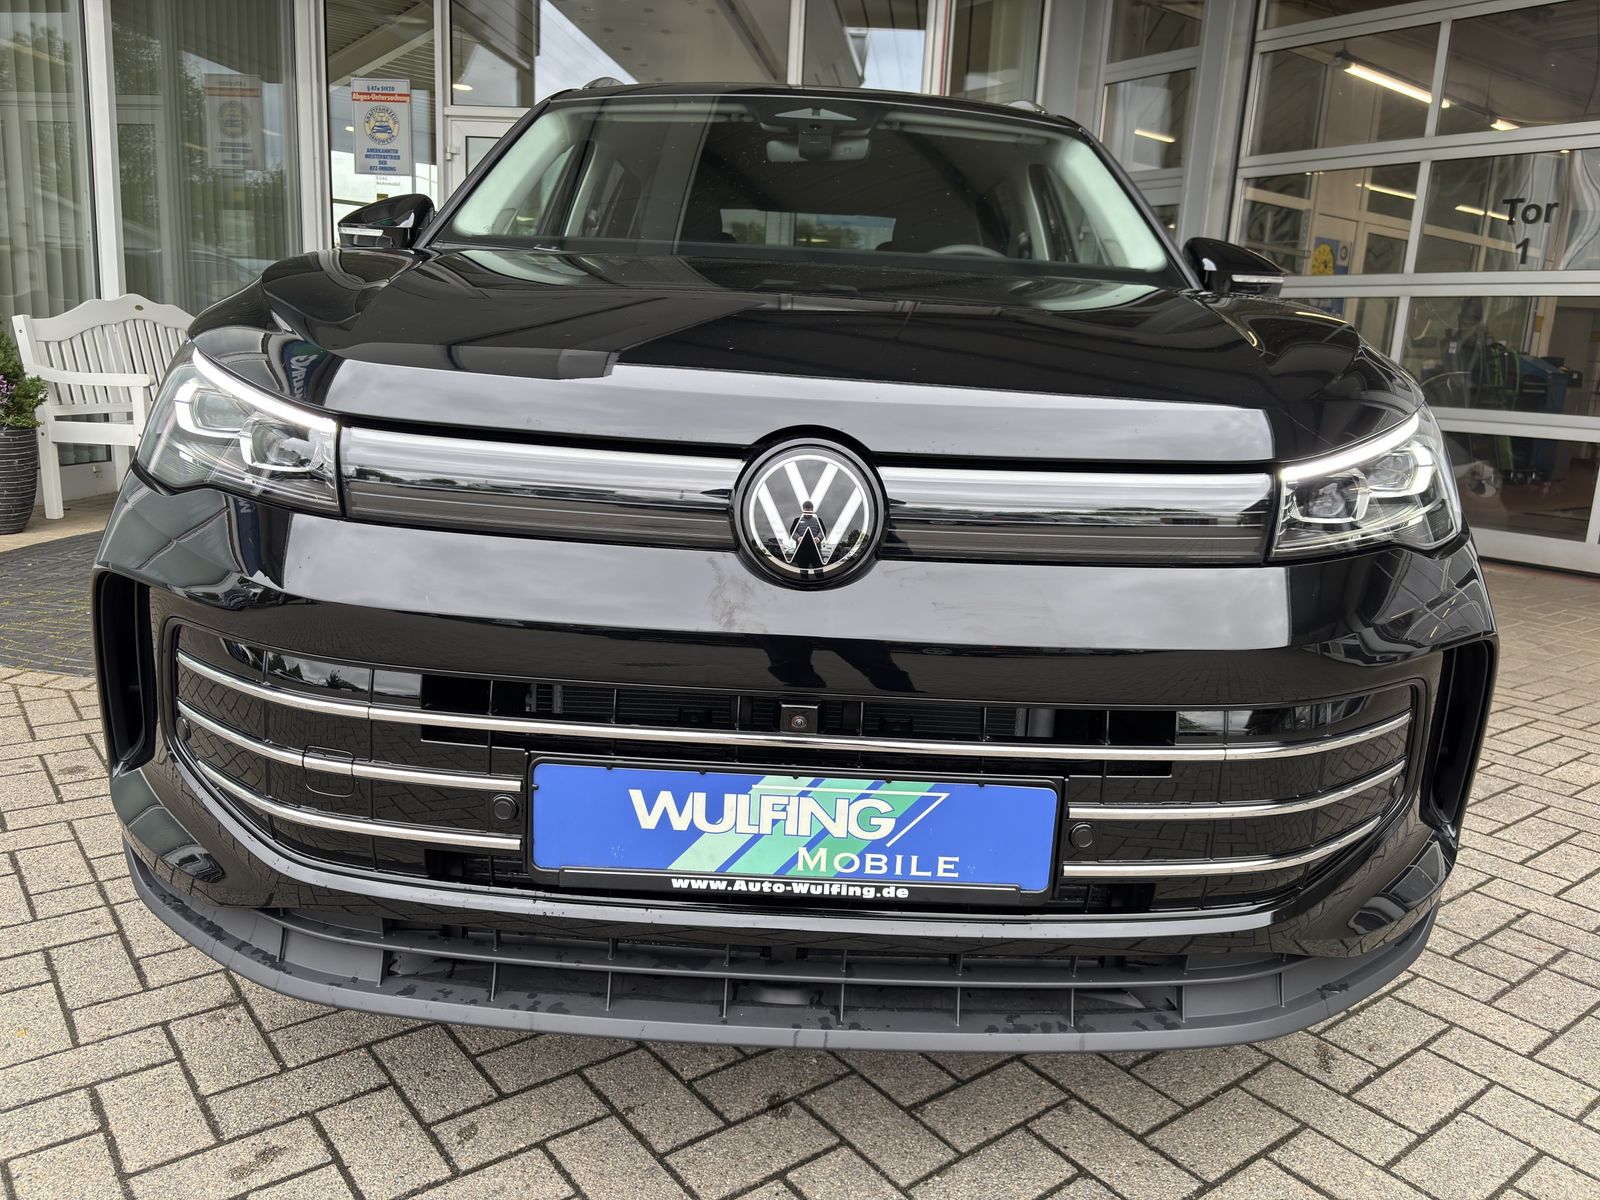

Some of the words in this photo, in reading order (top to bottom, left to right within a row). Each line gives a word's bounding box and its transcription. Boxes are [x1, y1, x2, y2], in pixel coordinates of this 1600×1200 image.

[1502, 198, 1560, 225] Tor
[1515, 238, 1530, 264] 1
[752, 457, 866, 568] VW
[627, 788, 897, 841] WULFING
[670, 878, 909, 899] www.Auto-Wulfing.de
